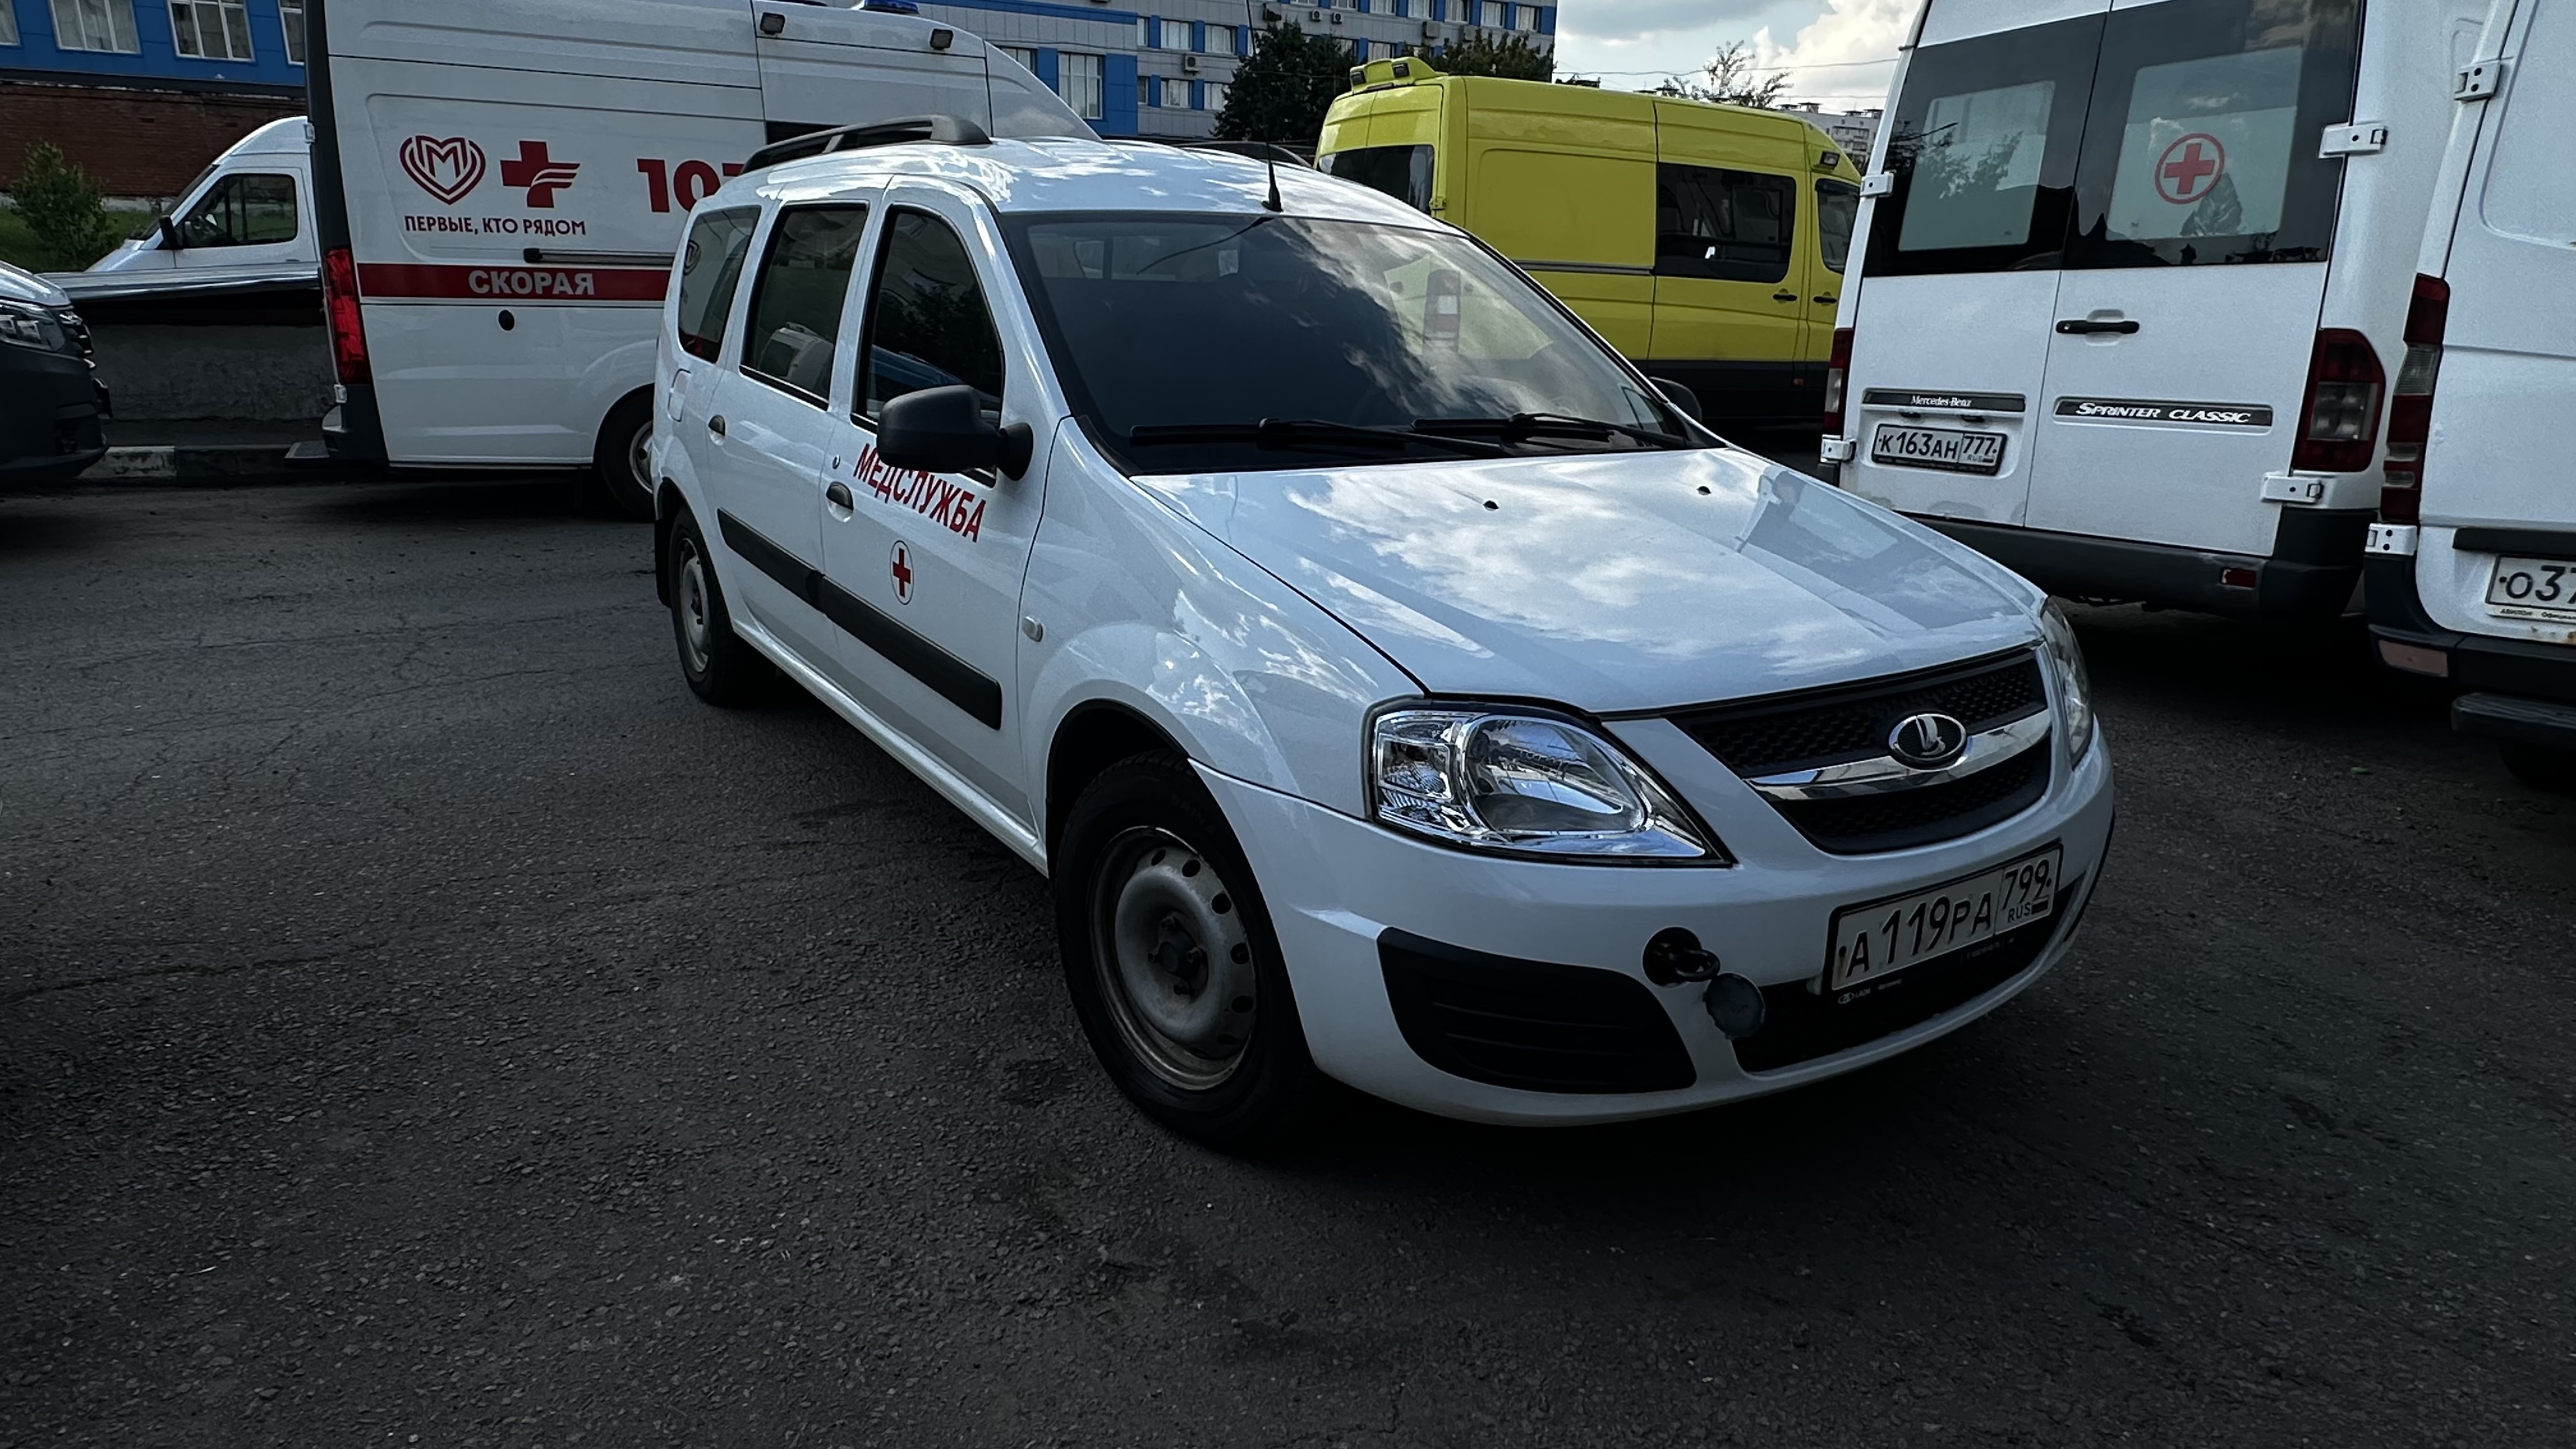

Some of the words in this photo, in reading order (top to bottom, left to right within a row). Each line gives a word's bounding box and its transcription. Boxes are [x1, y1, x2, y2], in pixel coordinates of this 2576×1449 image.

[637, 158, 744, 213] 10
[404, 215, 479, 235] ПЕРВЫЕ,
[482, 217, 518, 234] КТО
[523, 218, 586, 236] РЯДОМ
[468, 270, 595, 296] СКОРАЯ
[1910, 395, 1972, 407] Mercedes-Benz
[2168, 409, 2251, 423] CLASSIC
[1963, 436, 1996, 456] 777
[853, 443, 986, 542] МЕДСЛУЖБА
[2506, 565, 2576, 604] О3
[2002, 858, 2050, 910] 799
[2007, 901, 2032, 924] RUS
